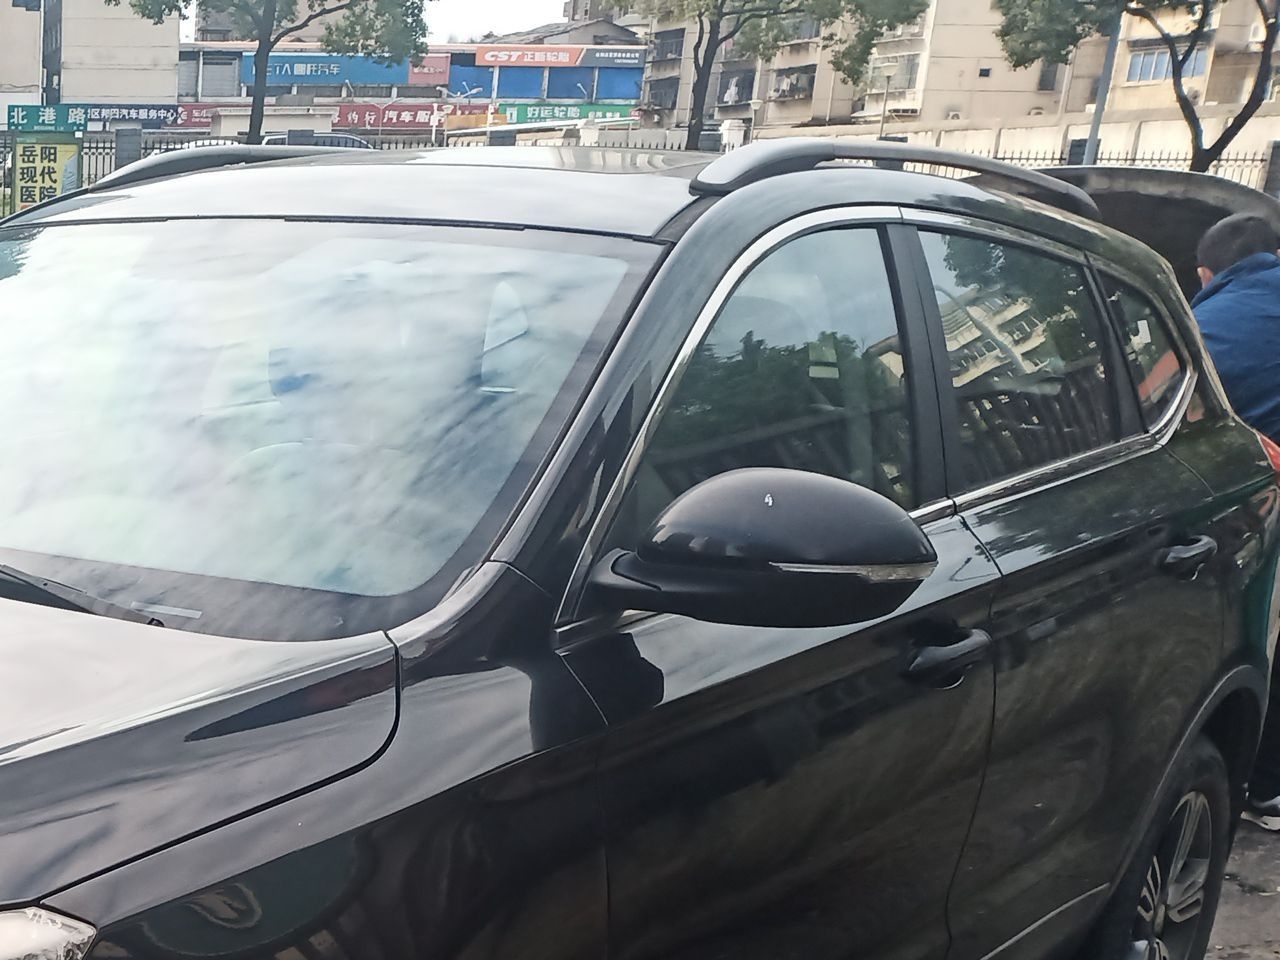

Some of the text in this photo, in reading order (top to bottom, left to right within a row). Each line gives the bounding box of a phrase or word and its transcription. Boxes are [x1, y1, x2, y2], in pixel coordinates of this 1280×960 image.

[484, 51, 522, 62] CST
[9, 107, 86, 124] 北港路
[526, 106, 580, 118] 好运轮胎
[19, 145, 58, 164] 岳阳
[19, 165, 58, 184] 现代
[19, 185, 58, 203] 医院
